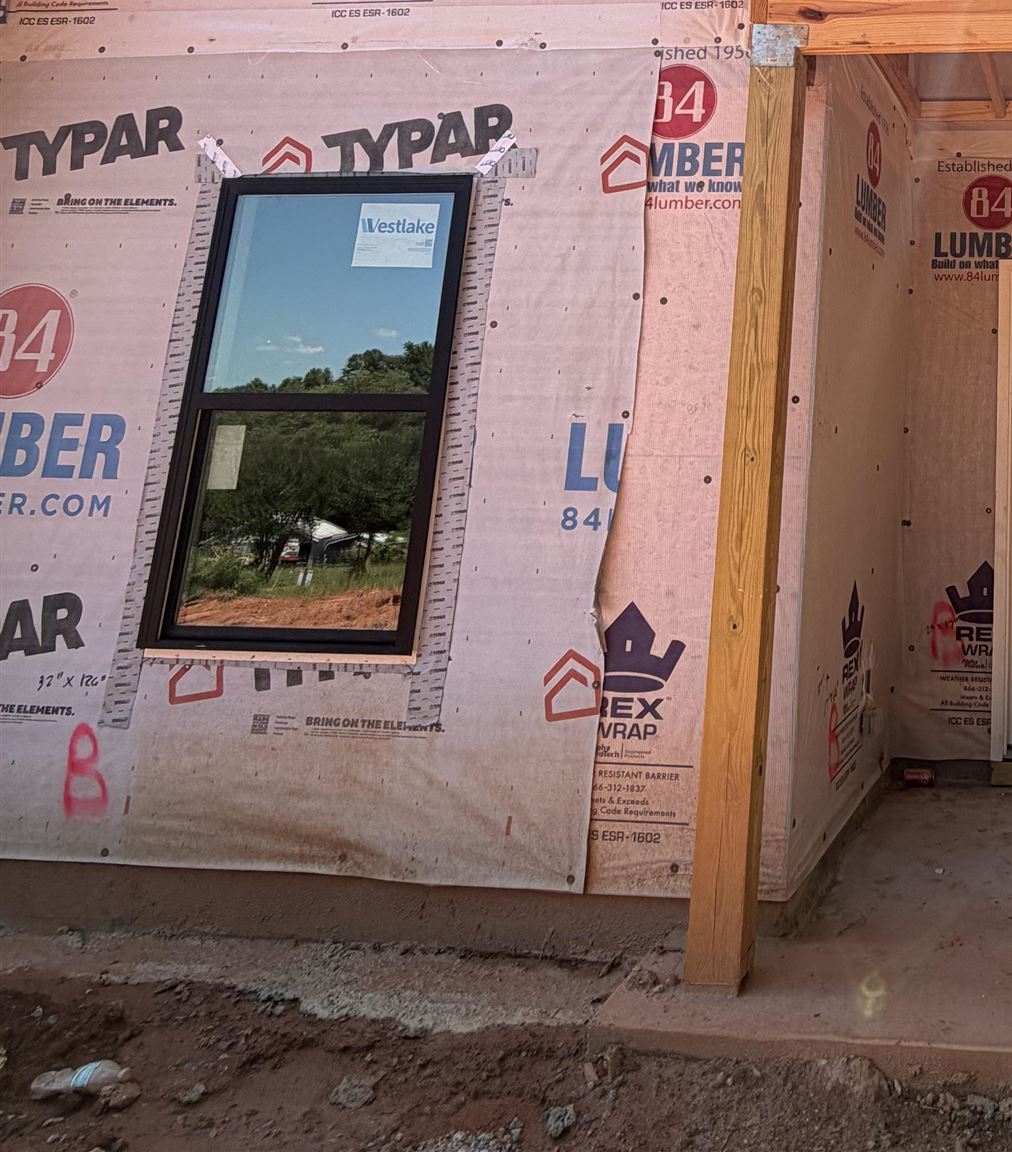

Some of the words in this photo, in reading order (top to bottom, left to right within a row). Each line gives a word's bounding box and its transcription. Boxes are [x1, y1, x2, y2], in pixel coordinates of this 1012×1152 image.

[661, 1, 677, 10] ICC
[680, 1, 692, 9] ES
[331, 10, 347, 18] ICC
[19, 17, 36, 25] ICC
[0, 105, 185, 181] TYPAR
[650, 142, 745, 176] MBER
[937, 161, 1012, 172] Established
[647, 180, 680, 193] what
[708, 180, 742, 193] know
[57, 198, 87, 207] BRING
[88, 198, 101, 206] ON
[104, 198, 122, 206] THE
[124, 198, 177, 207] ELEMENTS.
[856, 174, 886, 232] LUMBER
[970, 187, 1012, 218] 84
[361, 217, 435, 234] Westlake
[931, 259, 956, 269] Build
[959, 260, 971, 269] on
[974, 259, 999, 269] what
[0, 412, 126, 479] BER
[956, 626, 992, 641] RE
[16, 705, 75, 716] ELEMENTS.
[306, 717, 340, 728] BRING
[342, 718, 359, 728] ON
[360, 719, 381, 729] THE
[964, 717, 974, 726] ES
[63, 722, 108, 821] B
[598, 770, 642, 779] RESISTANT
[645, 772, 680, 781] BARRIER
[617, 797, 649, 805] Exceeds
[600, 806, 621, 815] Code
[624, 807, 676, 818] Requirements
